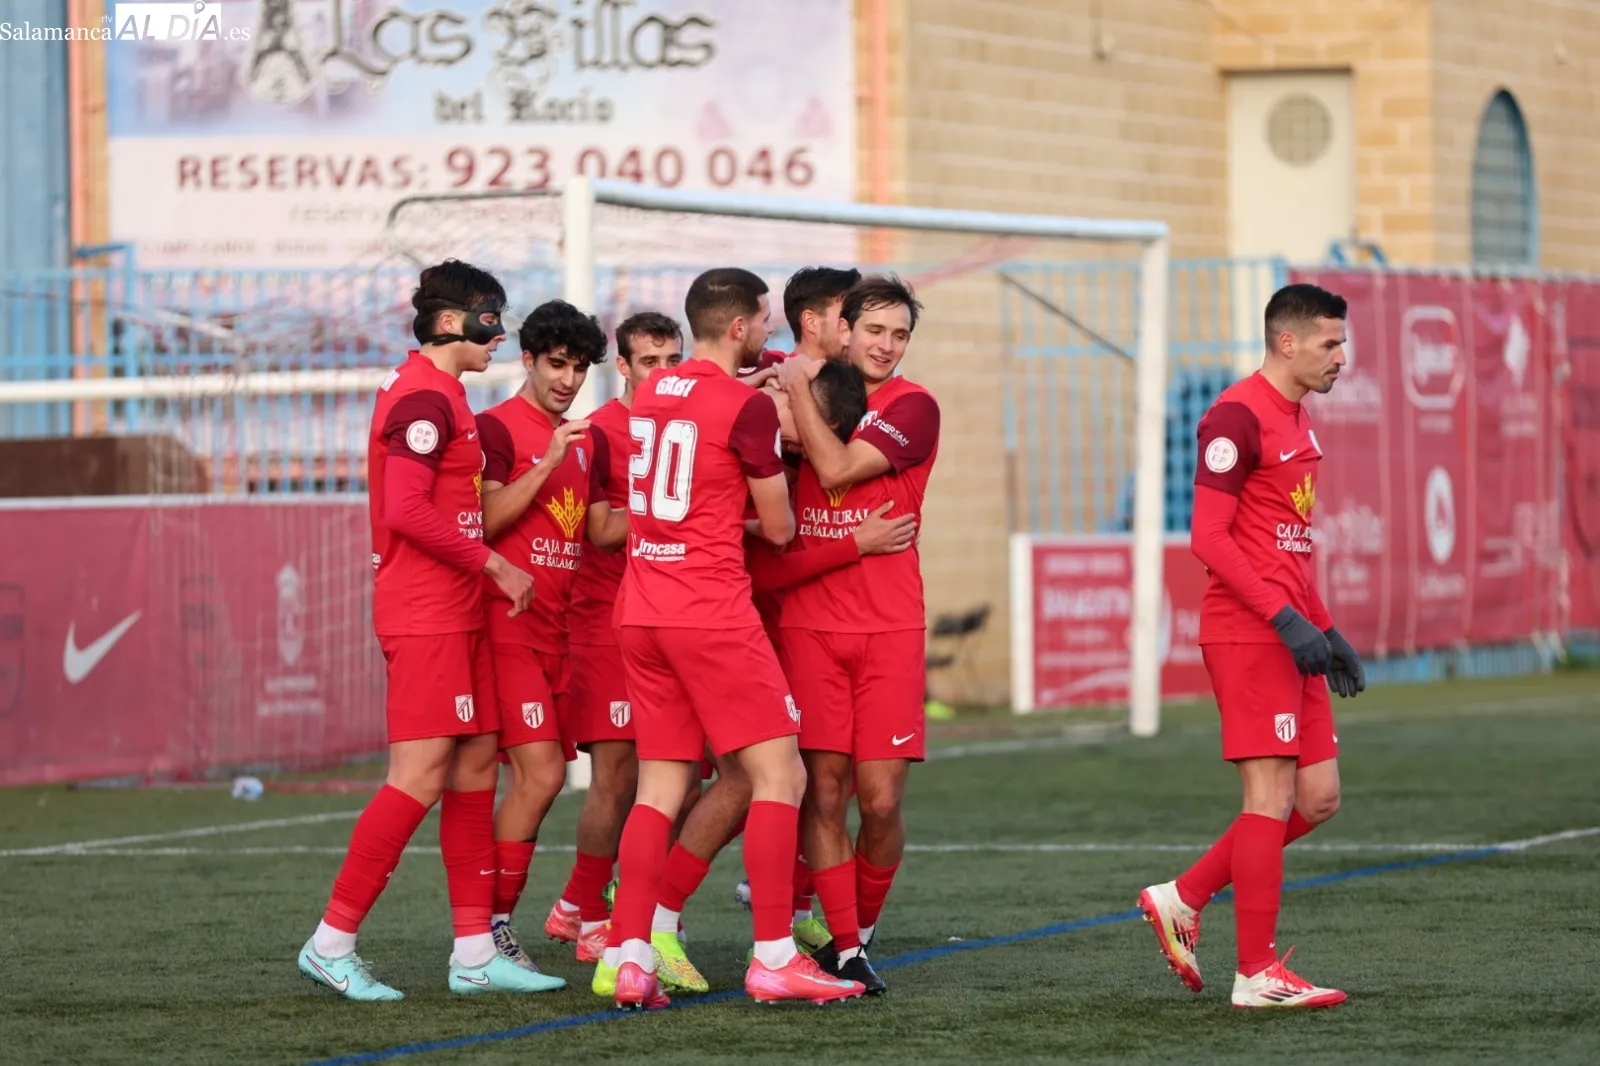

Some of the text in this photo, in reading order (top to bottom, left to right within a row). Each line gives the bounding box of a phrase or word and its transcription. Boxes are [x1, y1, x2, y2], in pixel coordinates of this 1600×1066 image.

[320, 0, 473, 75] Las
[444, 146, 551, 190] 923
[707, 146, 816, 188] 046
[628, 416, 698, 522] 20
[803, 507, 830, 525] CAJA
[799, 524, 812, 535] DE
[532, 537, 561, 556] CAJA
[530, 553, 546, 566] DE
